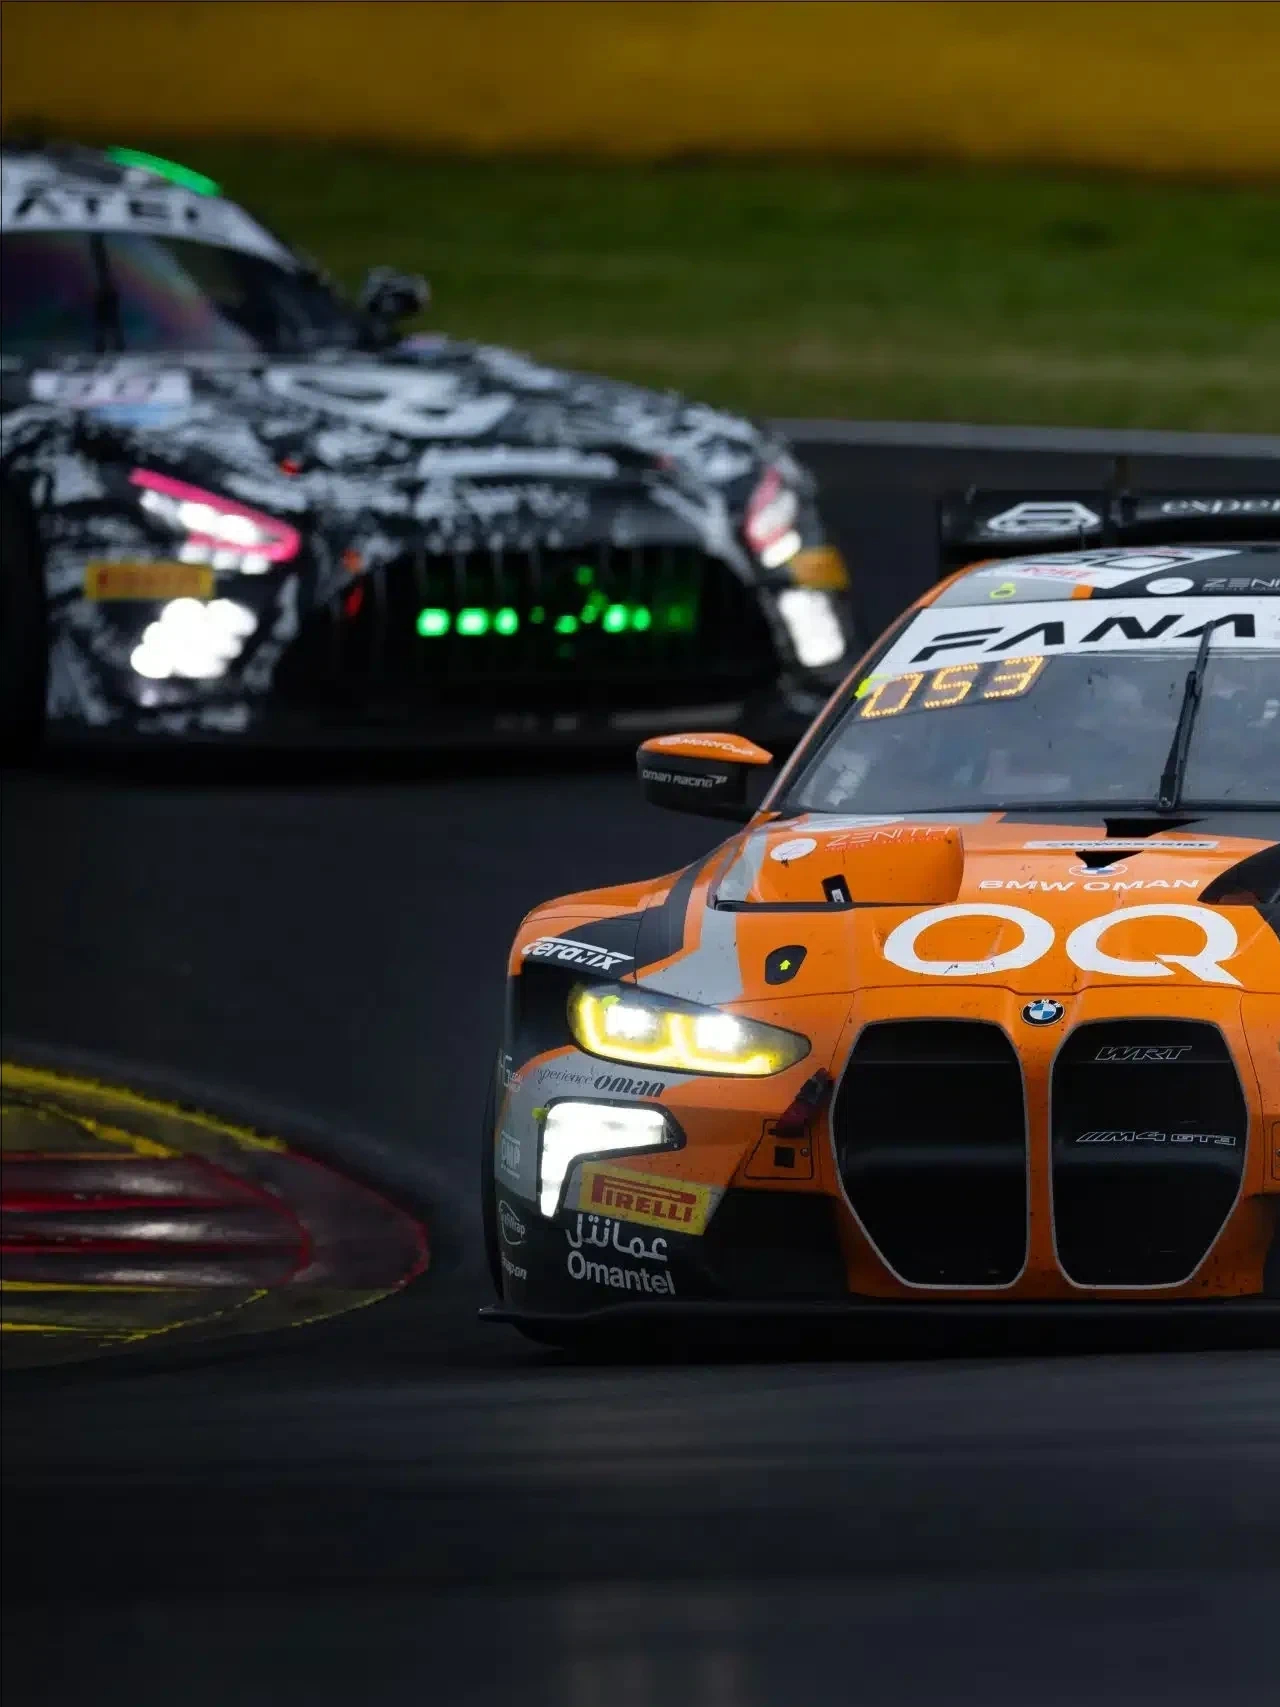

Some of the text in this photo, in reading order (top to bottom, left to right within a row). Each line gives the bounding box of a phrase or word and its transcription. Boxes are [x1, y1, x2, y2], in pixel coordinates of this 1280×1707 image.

[860, 656, 1044, 719] 053
[825, 826, 951, 848] ZENITH
[978, 879, 1200, 892] BMW OMAN
[883, 903, 1244, 987] OQ
[1095, 1045, 1192, 1060] WRT
[593, 1074, 666, 1097] oman
[1170, 1133, 1237, 1146] GT3
[591, 1174, 697, 1223] PIRELLI
[565, 1213, 669, 1262] عمانتل
[566, 1251, 676, 1296] Omantel
